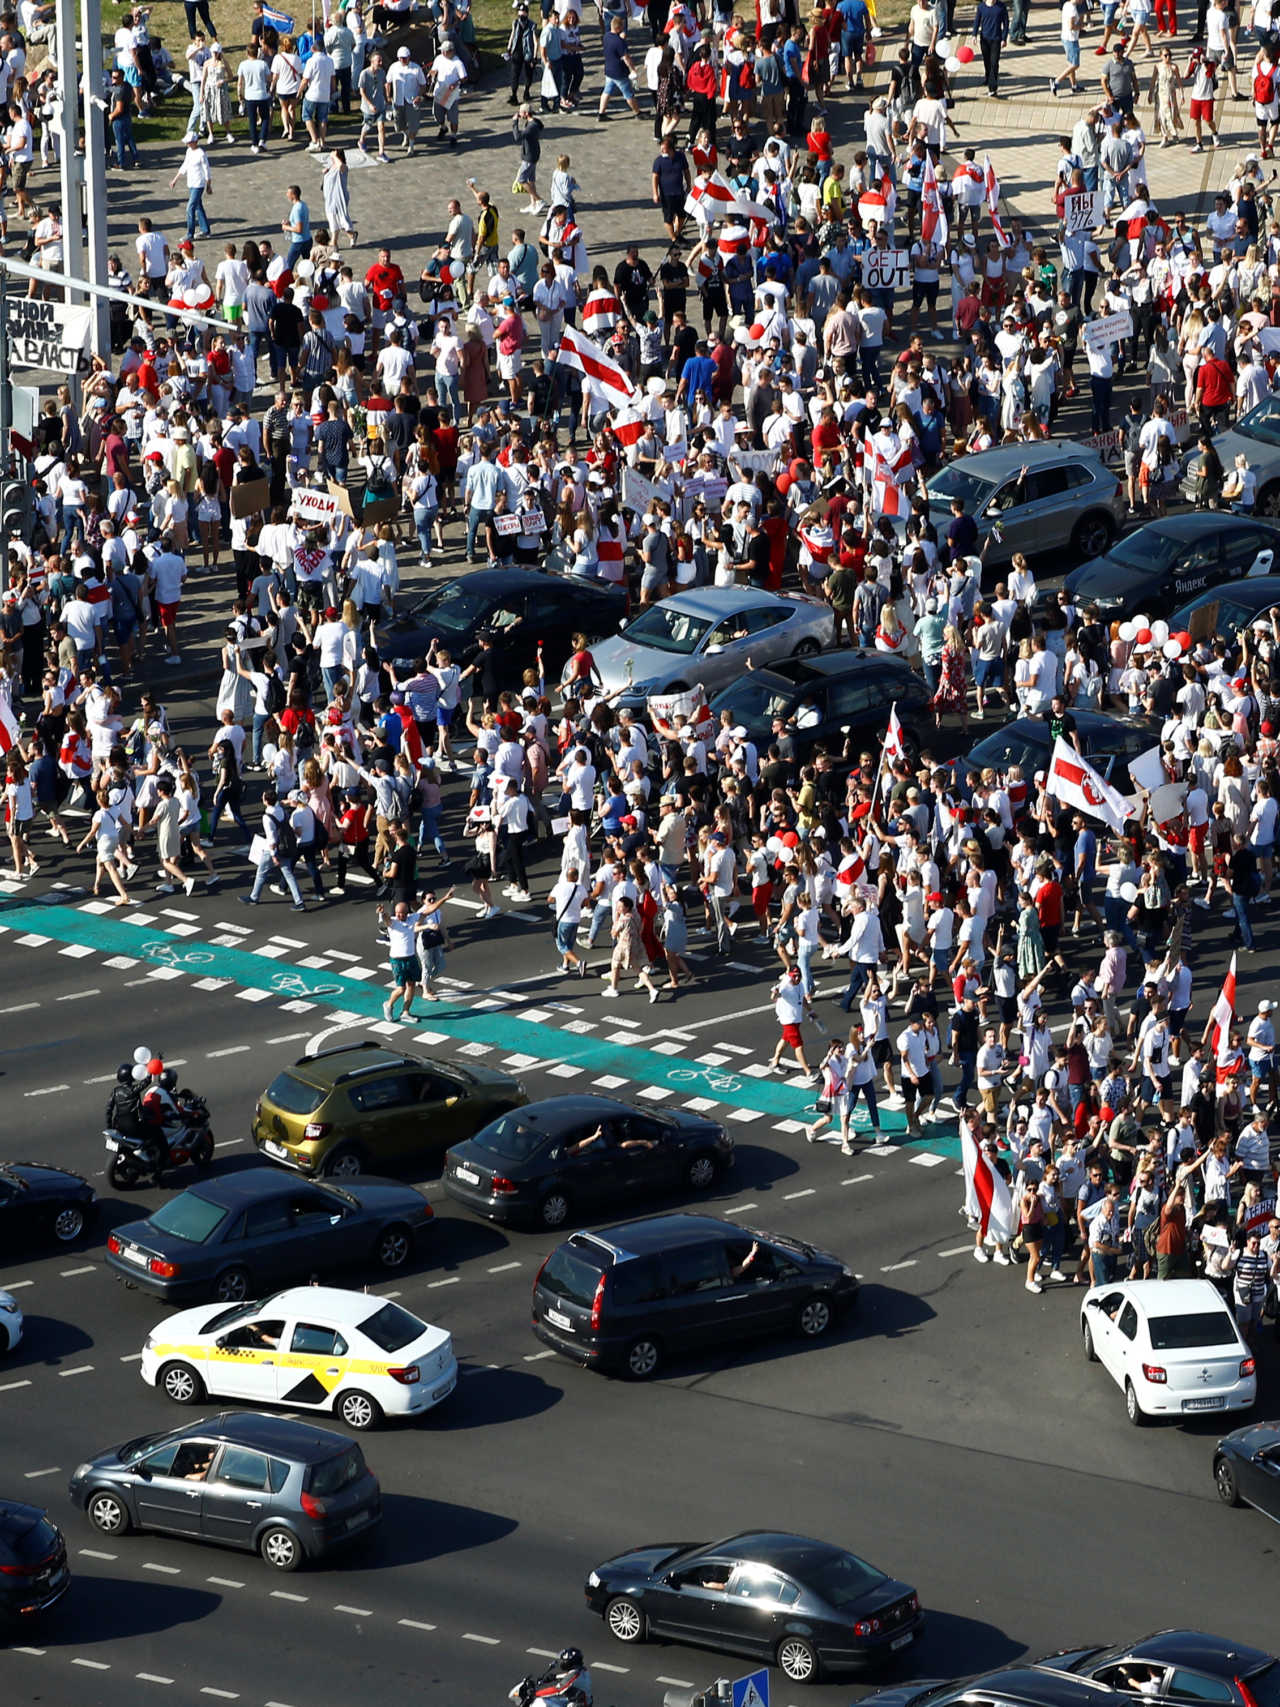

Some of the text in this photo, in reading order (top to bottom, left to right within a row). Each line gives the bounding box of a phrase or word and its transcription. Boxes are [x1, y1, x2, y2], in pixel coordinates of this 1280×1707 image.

[1071, 210, 1093, 229] 97%
[868, 250, 904, 267] GET
[868, 267, 909, 287] OUT
[24, 339, 88, 371] ВЛАСТЬ
[298, 493, 335, 513] УХОДИ
[1176, 575, 1208, 594] Яндекс
